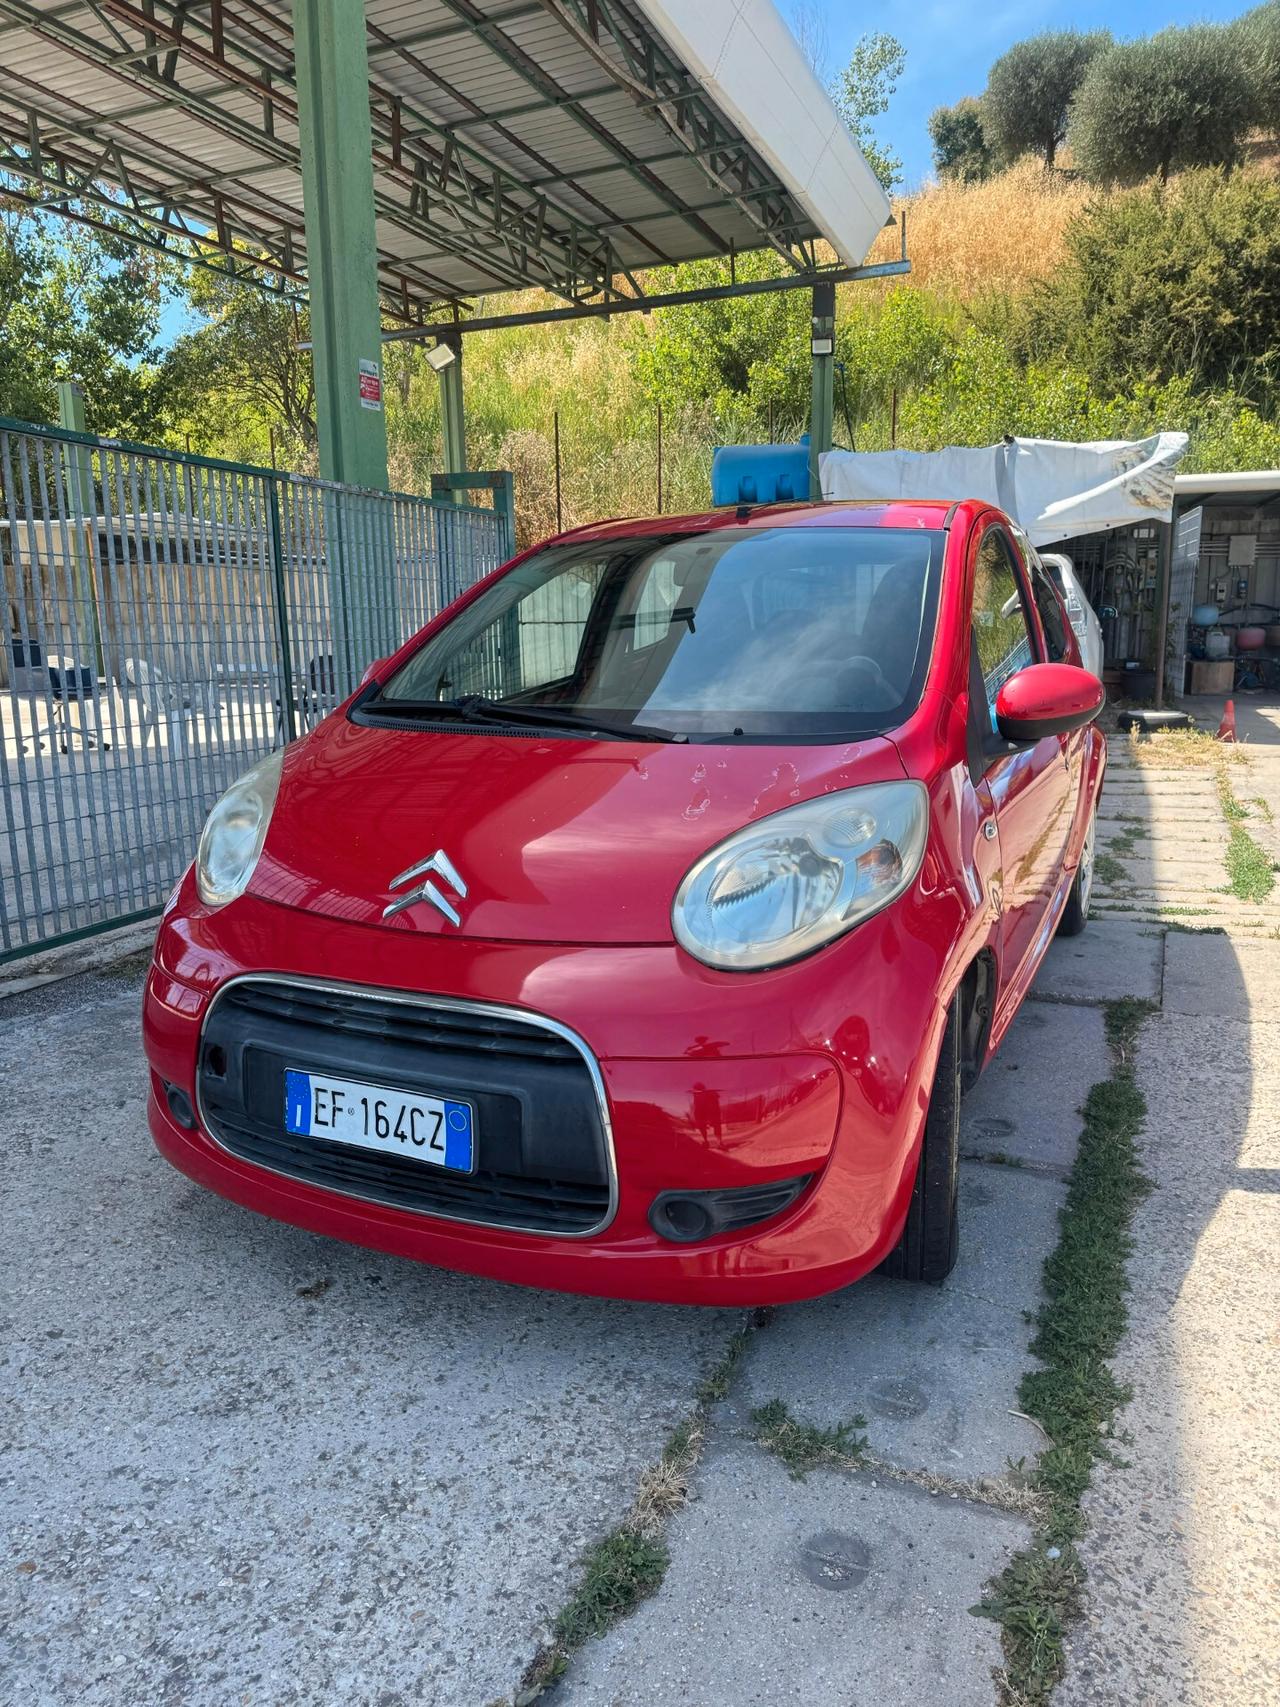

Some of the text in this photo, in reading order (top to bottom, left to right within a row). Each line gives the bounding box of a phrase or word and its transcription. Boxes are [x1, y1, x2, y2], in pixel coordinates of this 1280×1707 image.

[295, 1104, 302, 1127] I
[314, 1087, 444, 1151] EF 164CZ
